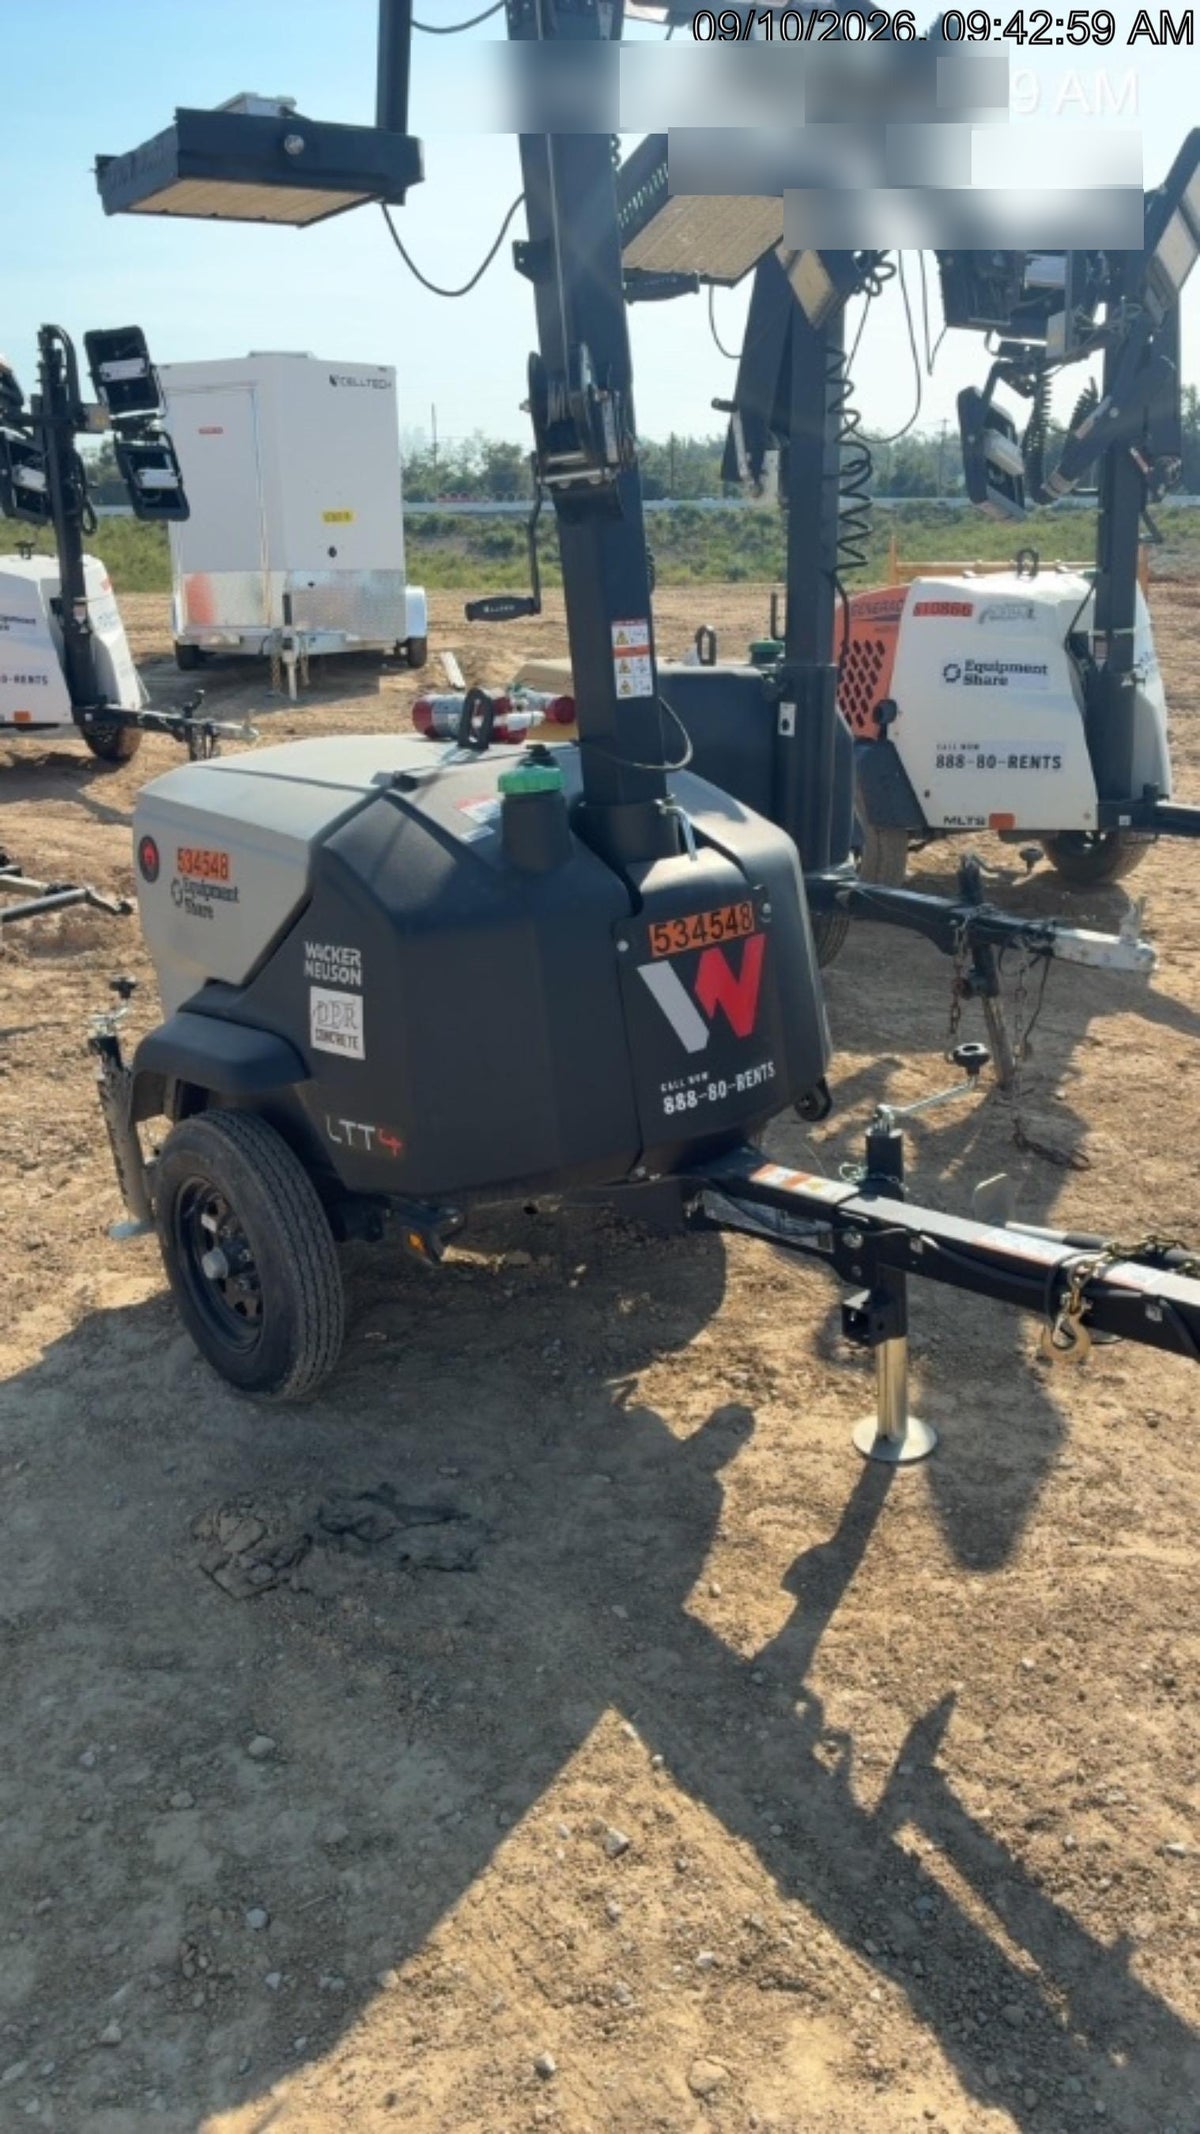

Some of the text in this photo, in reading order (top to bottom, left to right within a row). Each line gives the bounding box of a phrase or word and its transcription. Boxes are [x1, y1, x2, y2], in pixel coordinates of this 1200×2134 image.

[964, 659, 1048, 675] Equipment
[0, 674, 48, 686] 0-RENTS
[963, 674, 1008, 686] Share
[936, 754, 1062, 770] 888-80-RENTS
[177, 848, 229, 879] 534548
[183, 877, 240, 904] Equipment
[184, 897, 214, 919] Share
[652, 903, 753, 952] 534548
[304, 941, 361, 966] WACKER
[304, 960, 362, 986] NEUSON
[315, 1028, 359, 1050] CONCRETE
[663, 1061, 776, 1115] 888-80-RENTS
[326, 1115, 402, 1157] LTT4
